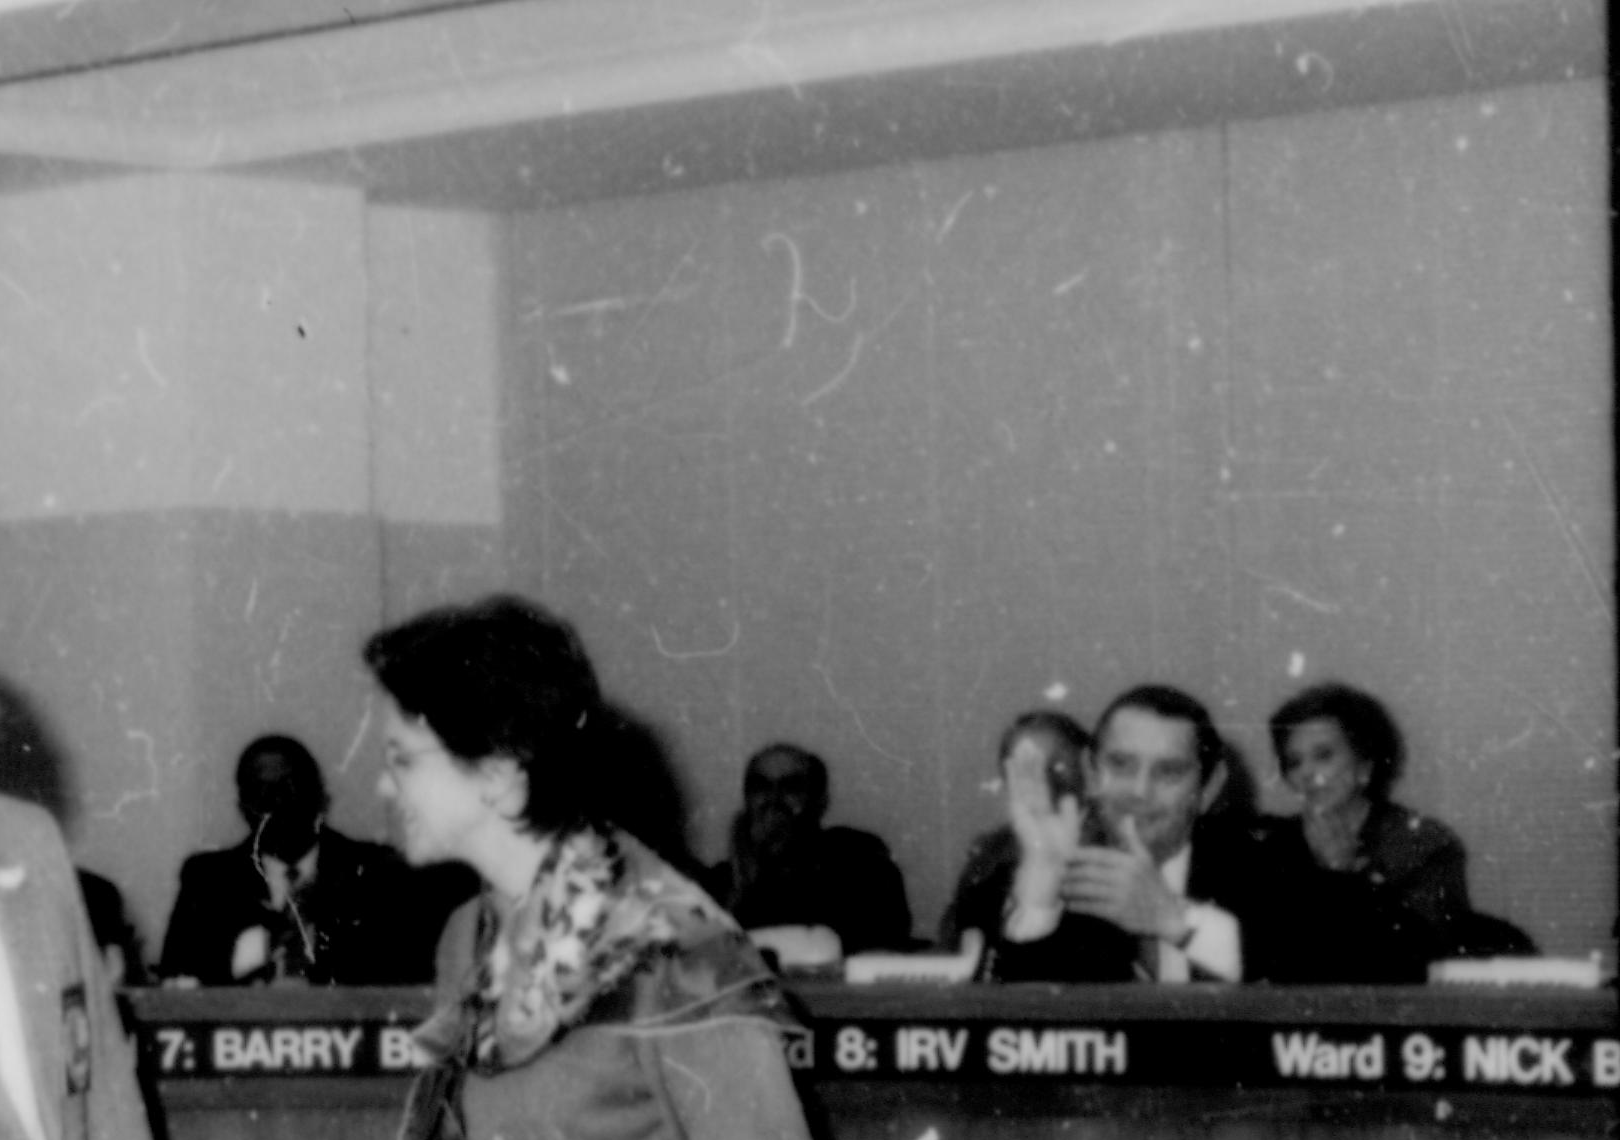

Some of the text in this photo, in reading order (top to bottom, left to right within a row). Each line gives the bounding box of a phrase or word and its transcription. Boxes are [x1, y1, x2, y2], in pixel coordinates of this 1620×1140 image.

[156, 1029, 196, 1070] 7:
[212, 1028, 363, 1070] BARRY
[834, 1026, 878, 1071] 8:
[895, 1027, 969, 1071] IRV
[986, 1027, 1128, 1074] SMITH
[1272, 1032, 1385, 1079] Ward
[1401, 1033, 1446, 1081] 9:
[1463, 1034, 1576, 1086] NICK
